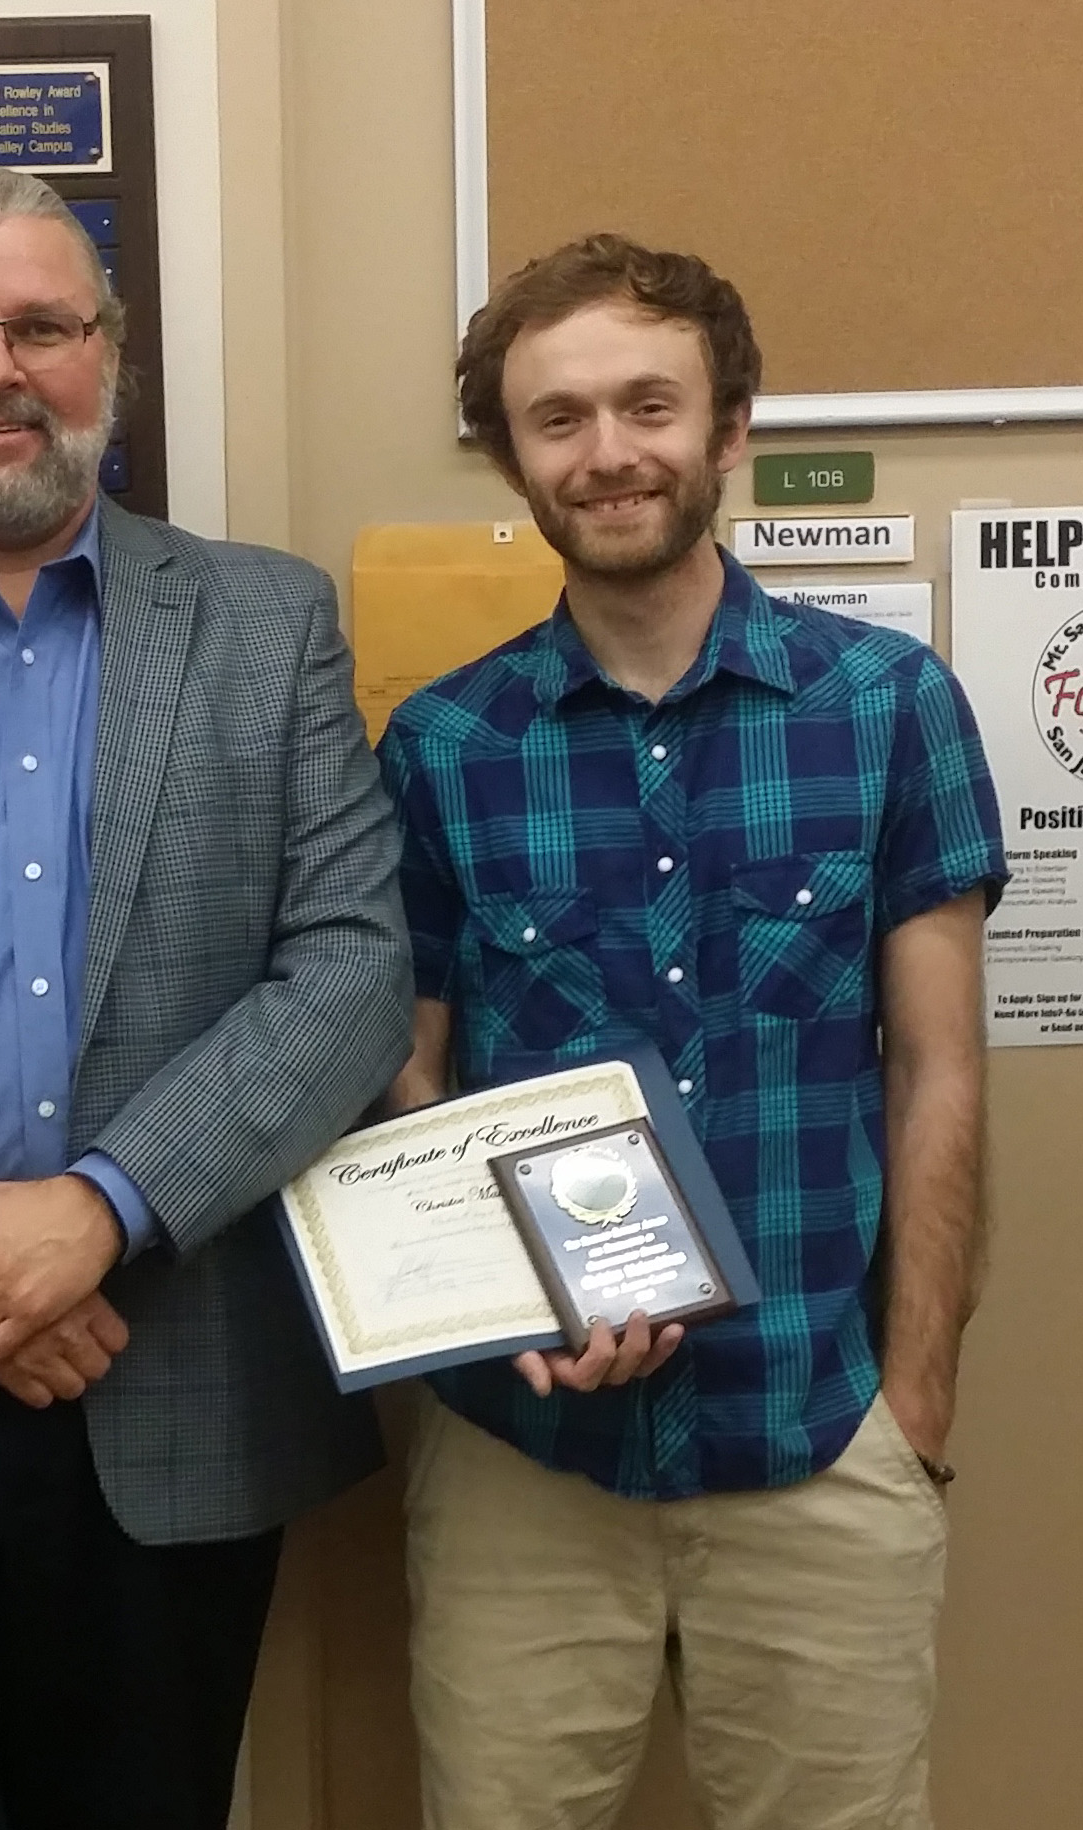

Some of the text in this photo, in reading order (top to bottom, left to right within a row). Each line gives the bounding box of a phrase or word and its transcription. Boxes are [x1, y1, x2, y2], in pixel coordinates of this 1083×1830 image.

[4, 86, 42, 101] Rowley
[47, 85, 81, 98] Award
[44, 103, 54, 116] in
[31, 122, 71, 135] Studies
[28, 140, 73, 154] Campus
[783, 470, 844, 489] L 106
[754, 522, 890, 547] Newman
[980, 520, 1083, 569] HELP
[1035, 571, 1080, 589] Com
[794, 591, 868, 606] Newman
[1047, 726, 1073, 762] San
[1033, 849, 1077, 860] Speaking
[988, 928, 1081, 940] Limited Preparation
[329, 1148, 447, 1186] Certificate
[452, 1132, 474, 1163] of
[476, 1114, 599, 1146] Excellence
